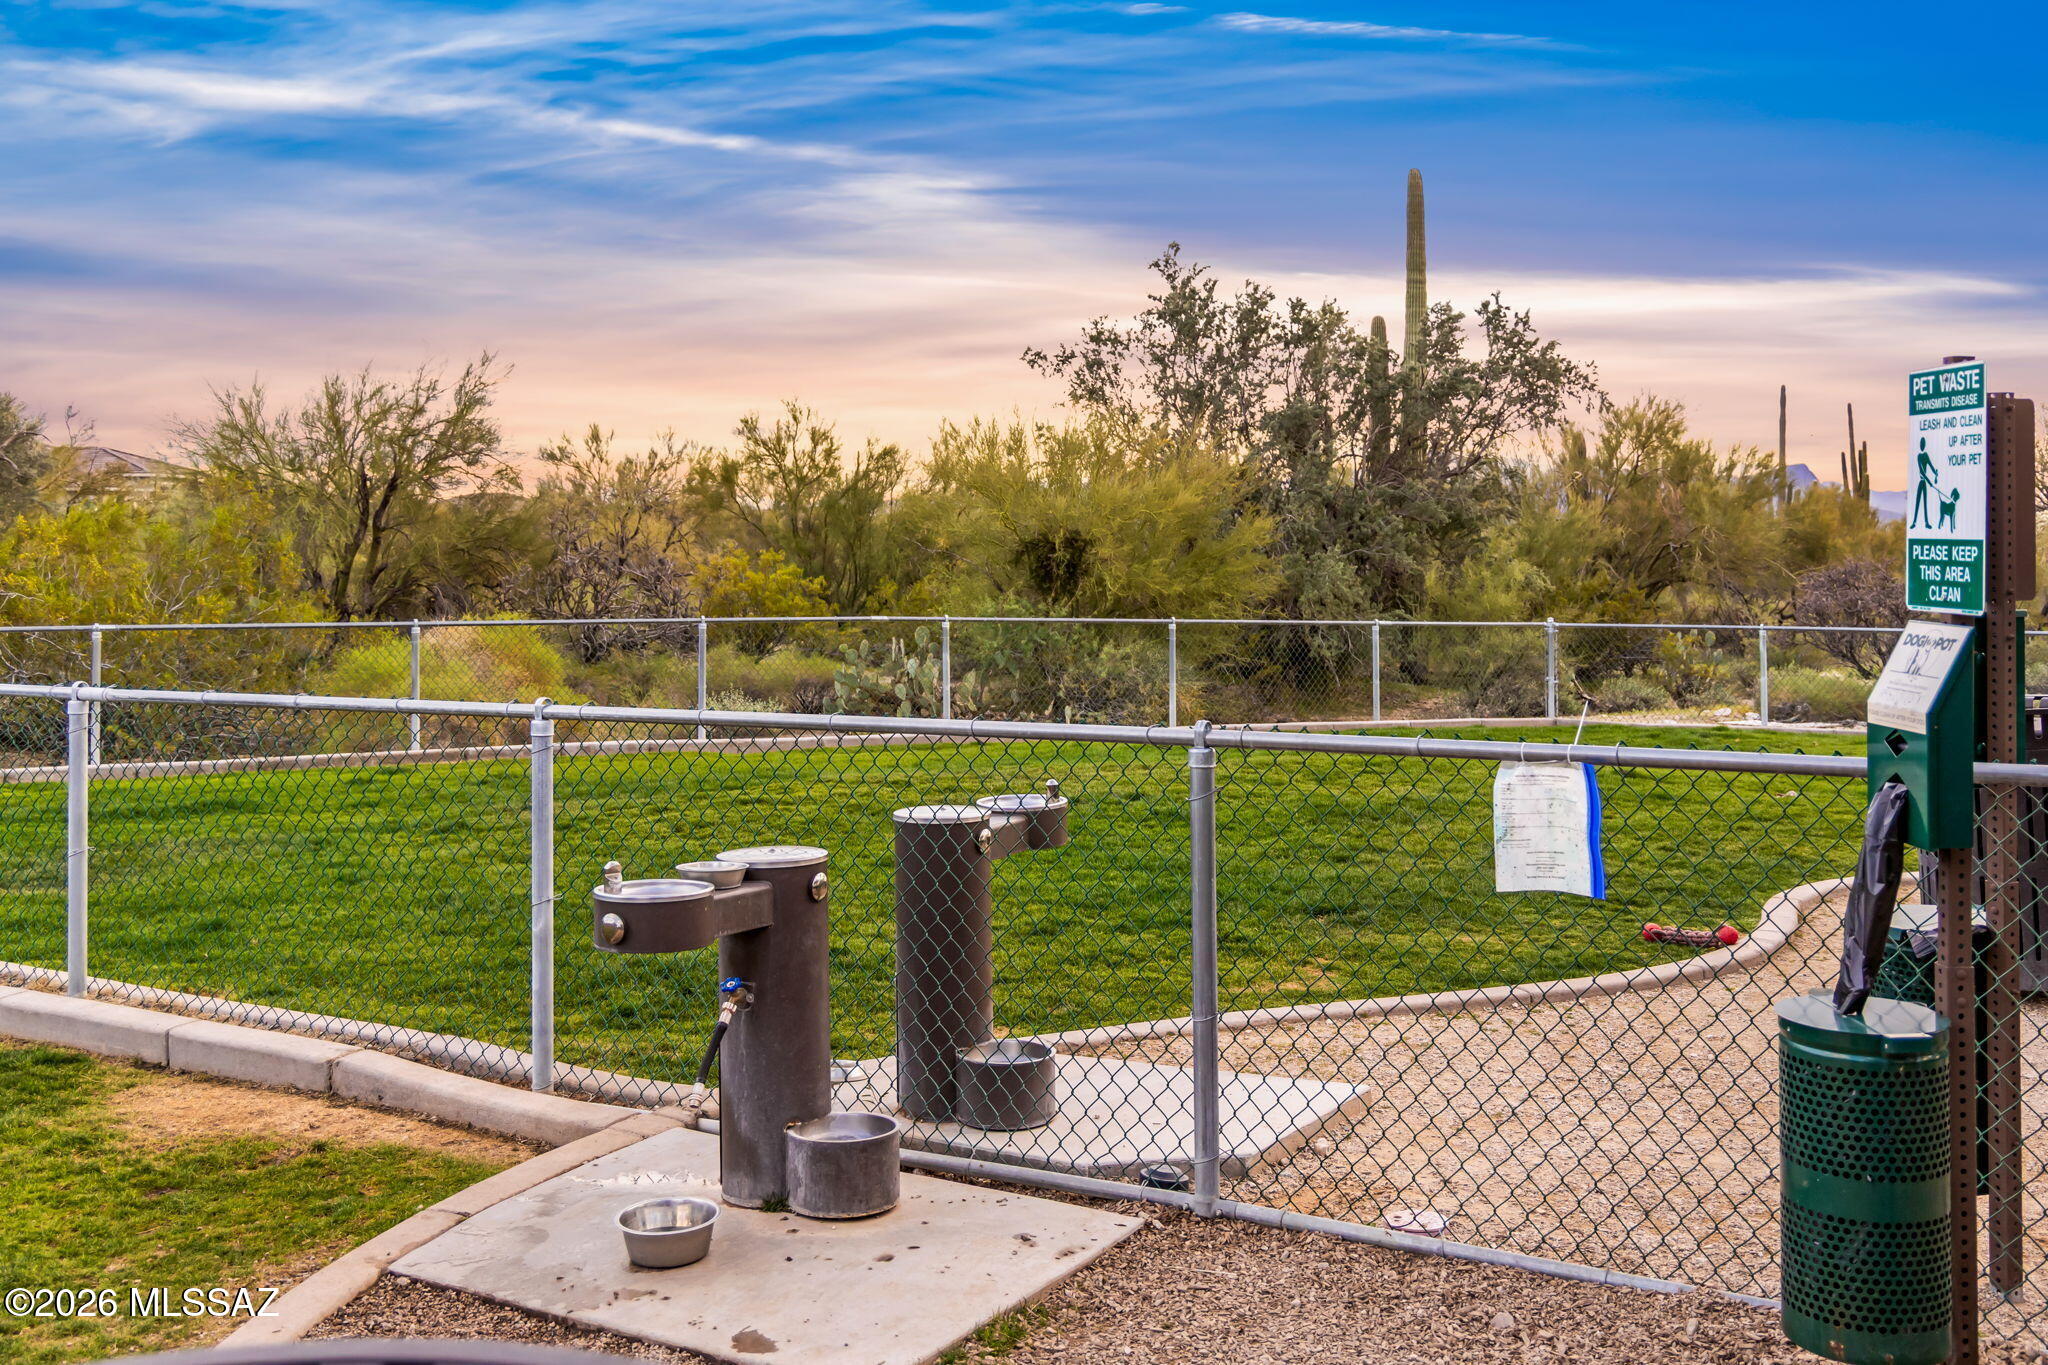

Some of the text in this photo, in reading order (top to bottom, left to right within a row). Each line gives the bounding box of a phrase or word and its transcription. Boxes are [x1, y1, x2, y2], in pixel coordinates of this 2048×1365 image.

[1913, 369, 1980, 396] PET WASTE
[1915, 394, 1978, 410] TRANSMITS DISEASE
[1920, 414, 1983, 431] LEASH AND CLEAN
[1949, 433, 1982, 447] UP AFTER
[1948, 453, 1982, 466] YOUR PET
[1913, 545, 1978, 561] PLEASE KEEP
[1920, 565, 1971, 582] THIS AREA
[1929, 585, 1961, 602] CLEAN
